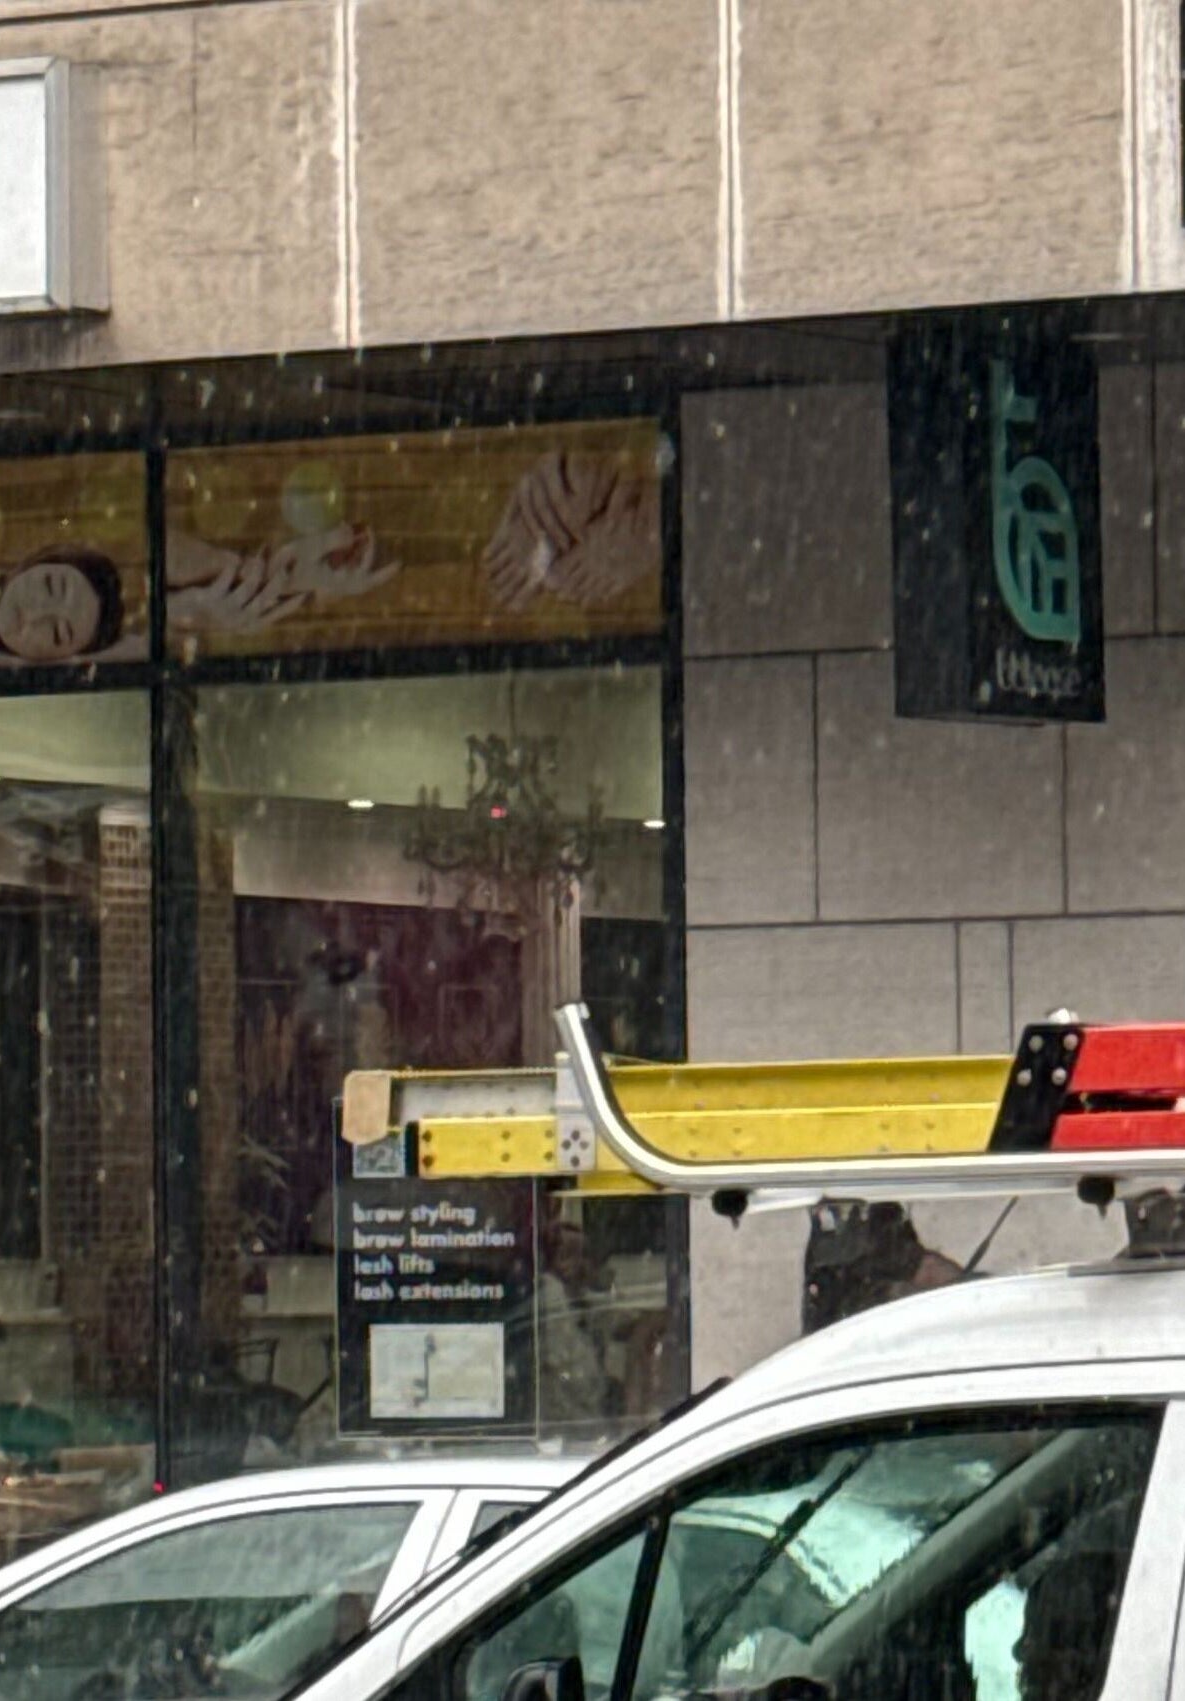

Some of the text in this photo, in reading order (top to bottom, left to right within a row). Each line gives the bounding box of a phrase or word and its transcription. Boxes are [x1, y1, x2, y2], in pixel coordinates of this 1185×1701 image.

[410, 1201, 477, 1226] styling
[410, 1226, 515, 1248] lamination
[354, 1279, 505, 1301] lash extensions
